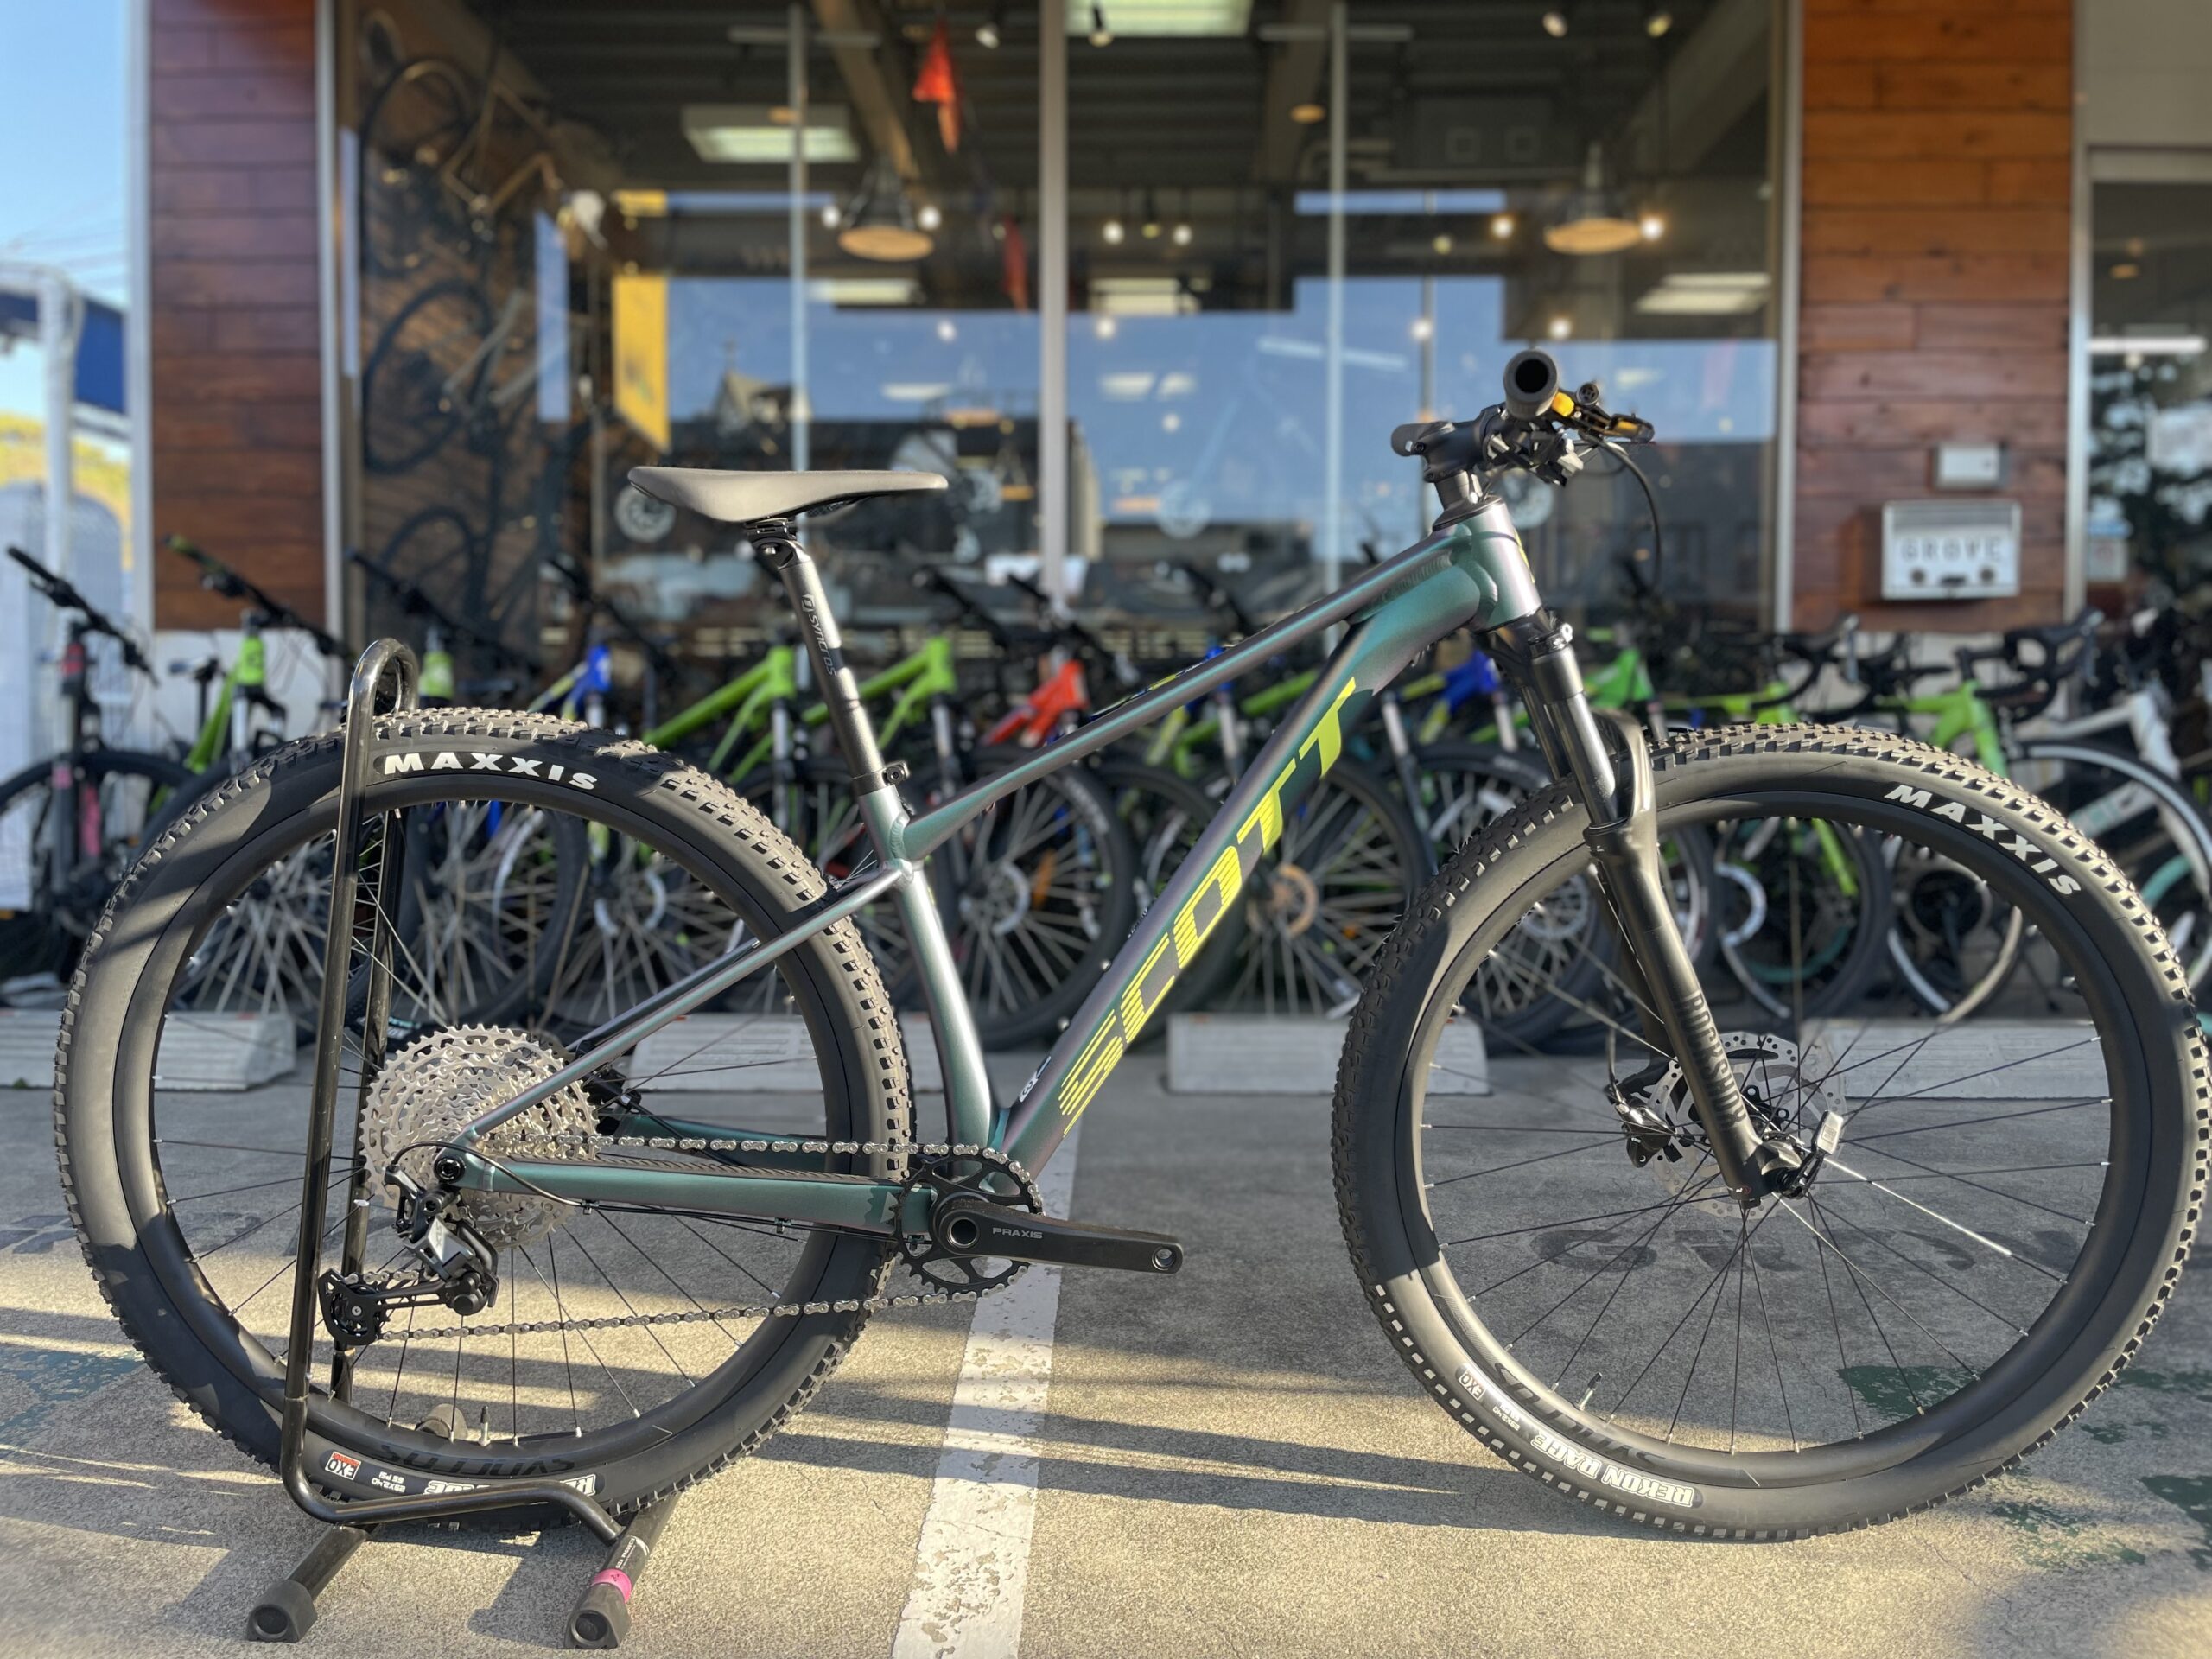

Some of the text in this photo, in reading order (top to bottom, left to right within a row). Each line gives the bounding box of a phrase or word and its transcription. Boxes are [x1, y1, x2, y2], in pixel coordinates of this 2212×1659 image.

[384, 752, 598, 790] MAXXIS
[1884, 785, 2082, 895] MAXXIS
[1058, 677, 1356, 1138] SCOTT
[1673, 989, 1747, 1129] ROCKSHOX
[992, 1227, 1043, 1239] PRAXIS
[1460, 1373, 1484, 1398] EXO
[327, 1459, 356, 1478] EXO
[1530, 1430, 1694, 1507] REKON RACE
